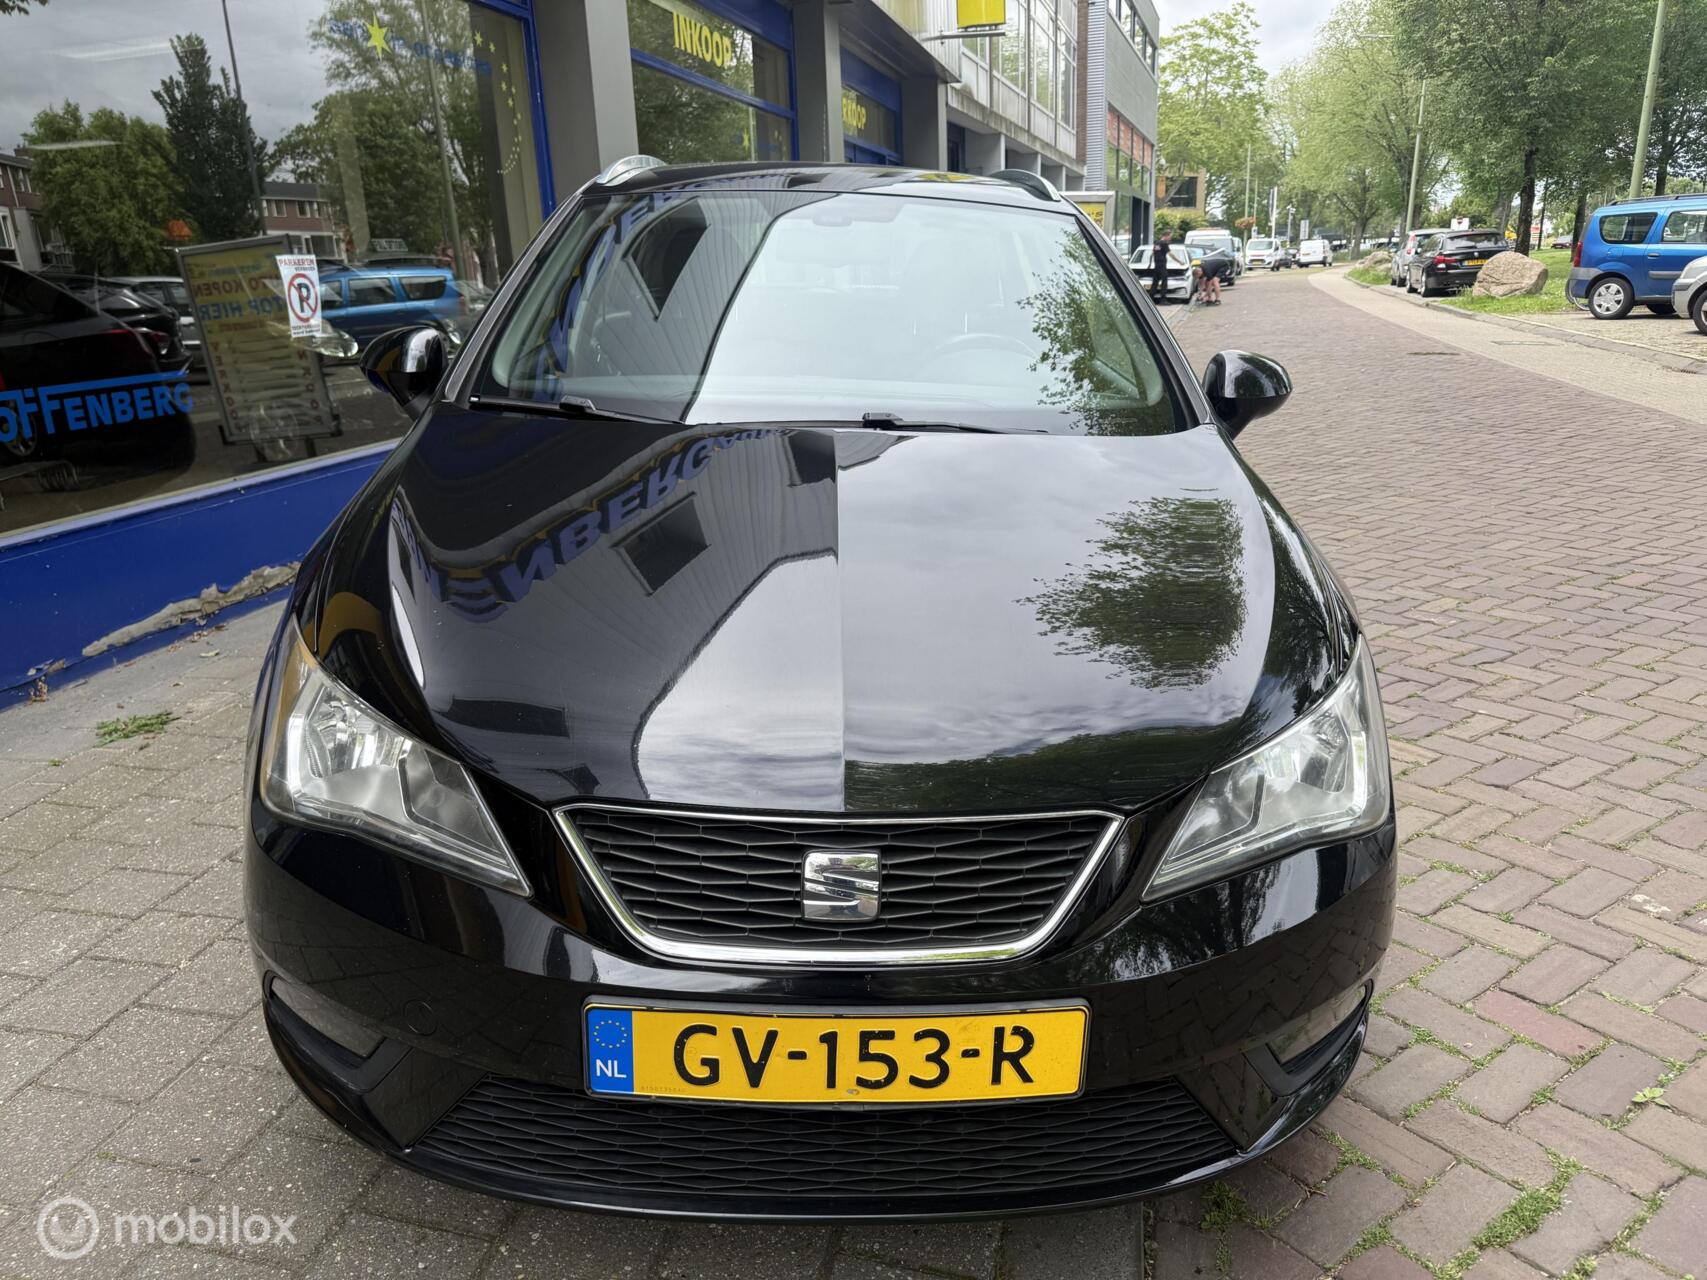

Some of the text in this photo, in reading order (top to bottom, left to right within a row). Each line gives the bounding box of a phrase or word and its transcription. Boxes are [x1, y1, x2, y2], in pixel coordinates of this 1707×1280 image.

[673, 10, 732, 69] INKOOP
[595, 1058, 627, 1079] NL
[673, 1023, 1035, 1089] GV-153-R
